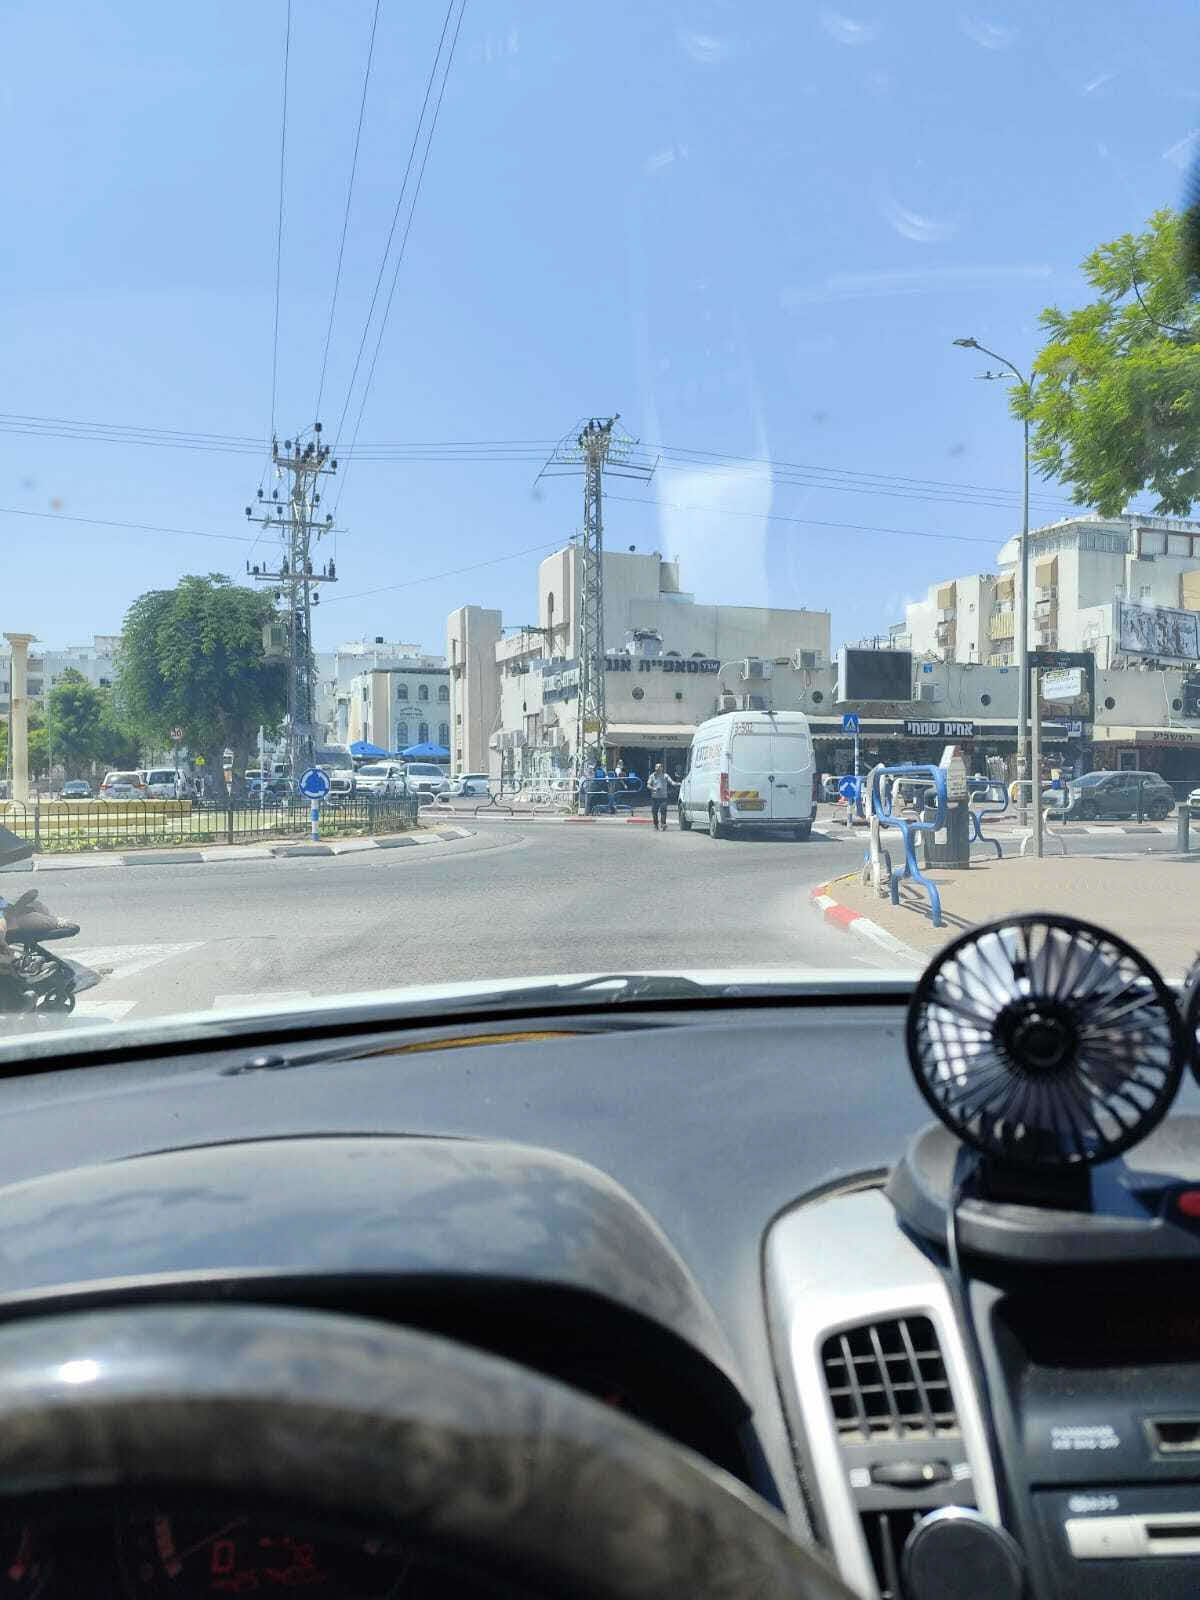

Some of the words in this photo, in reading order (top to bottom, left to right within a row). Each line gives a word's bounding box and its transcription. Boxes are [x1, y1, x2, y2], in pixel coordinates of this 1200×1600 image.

[639, 659, 699, 673] מאפיית
[907, 721, 941, 735] שמחי
[944, 722, 974, 736] אחים
